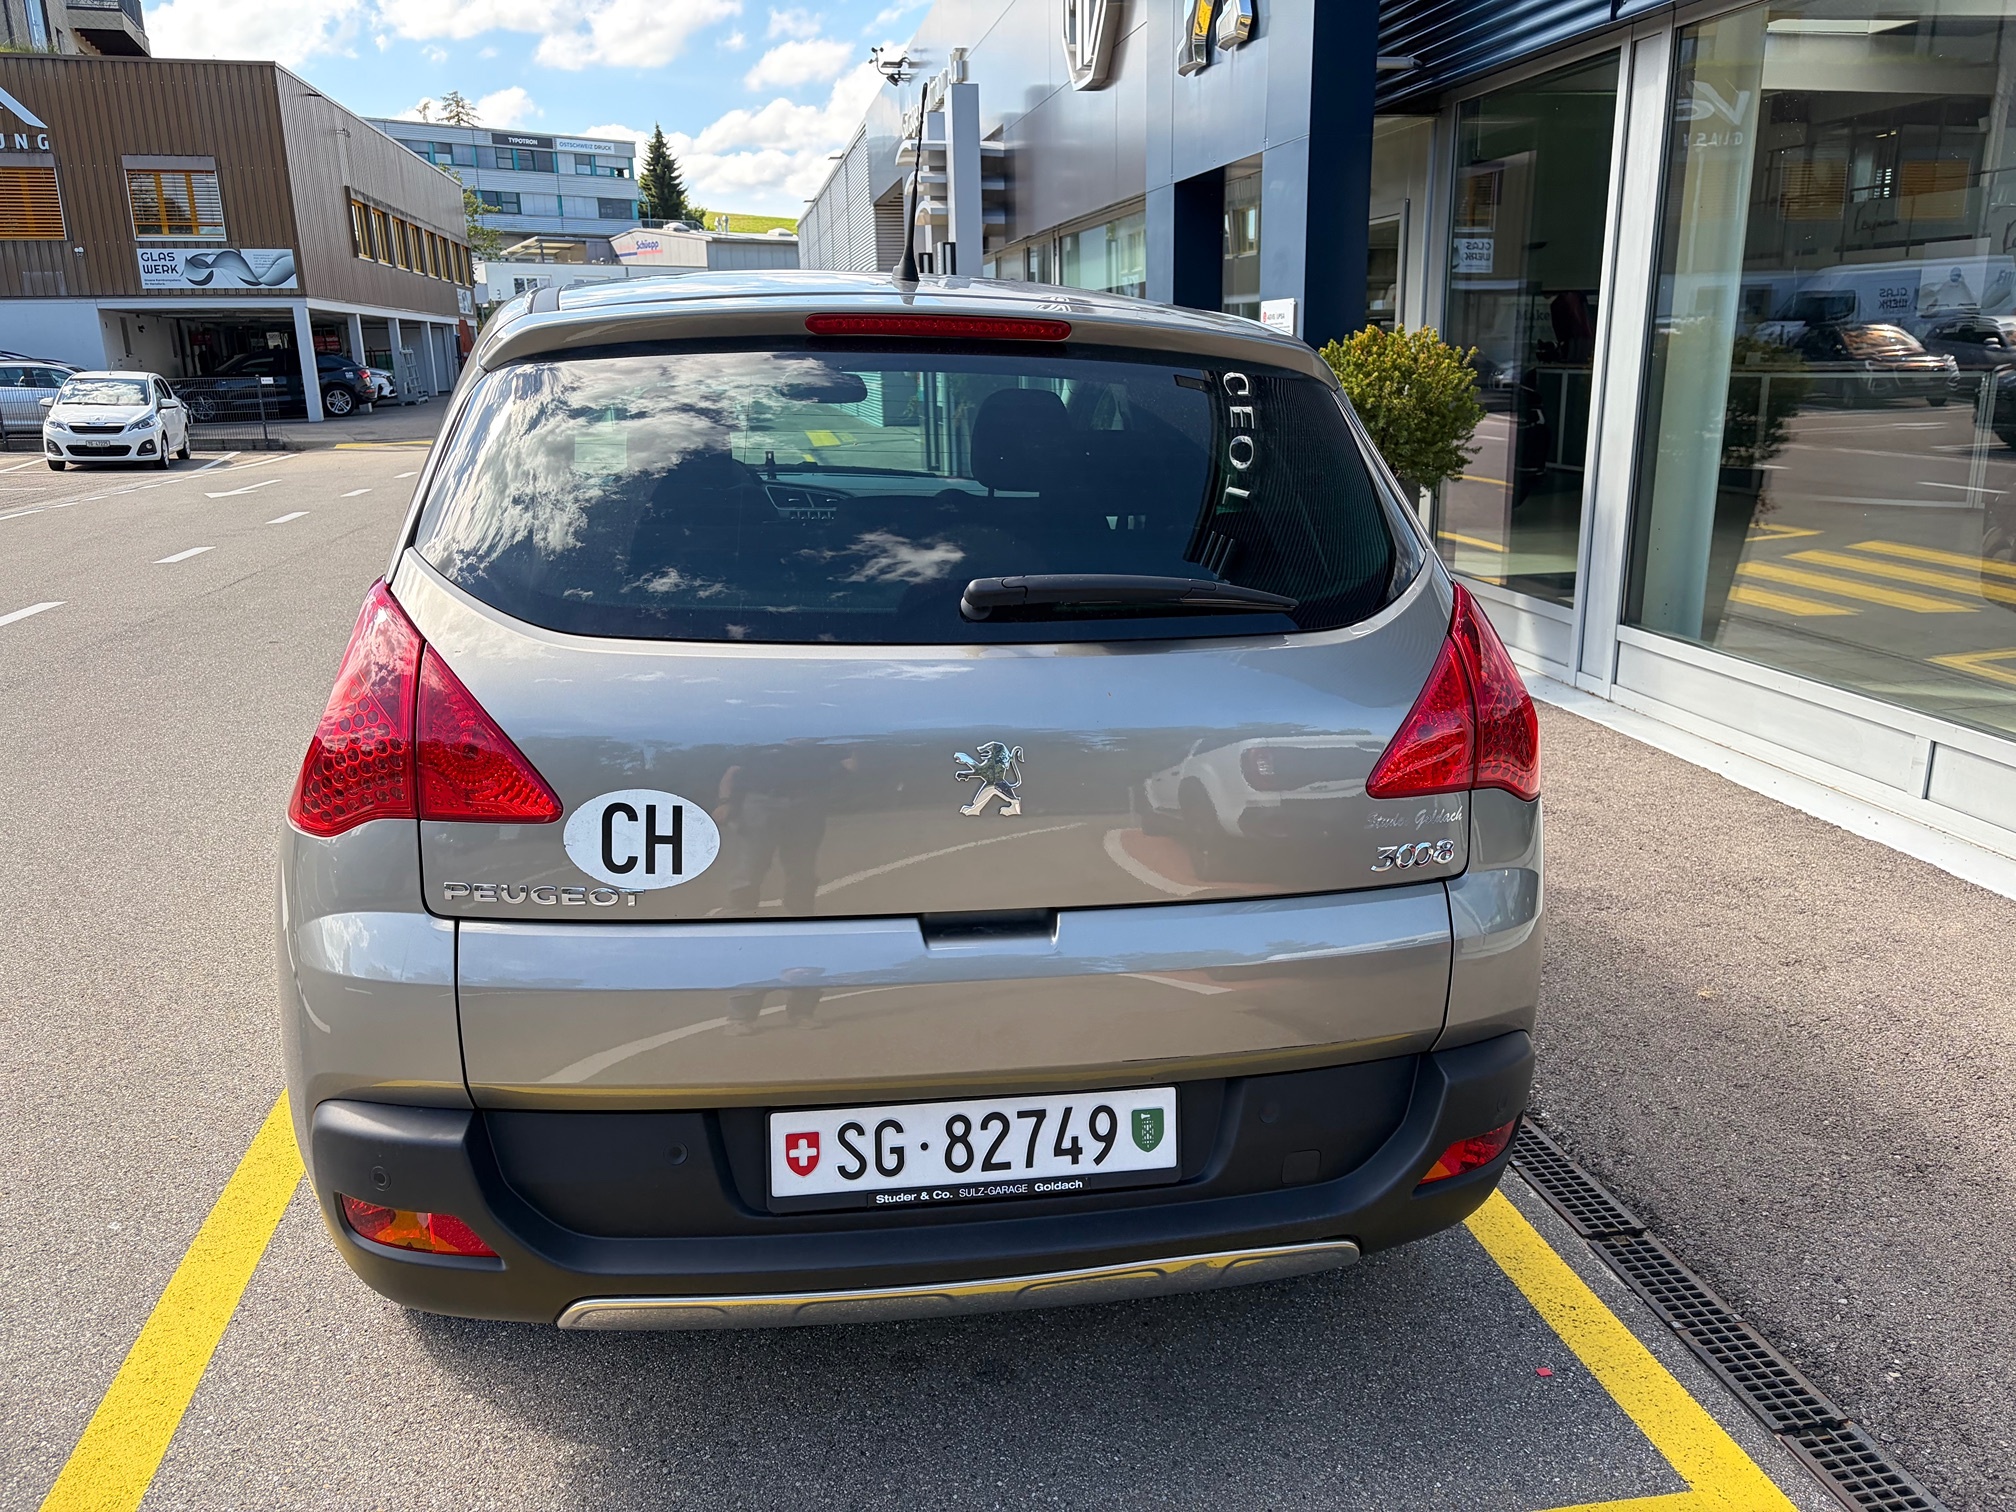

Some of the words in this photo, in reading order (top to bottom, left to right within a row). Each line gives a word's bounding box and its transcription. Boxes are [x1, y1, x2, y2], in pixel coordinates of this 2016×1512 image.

[508, 136, 538, 146] TYPOTRON
[558, 141, 594, 150] OSTSCHWEIZ
[594, 143, 612, 151] DRUCK
[140, 252, 175, 262] GLAS
[142, 264, 179, 275] WERK
[1414, 805, 1463, 831] Goldach
[601, 802, 683, 875] CH
[1370, 838, 1455, 872] 3008
[443, 881, 645, 907] PEUGEOT
[836, 1118, 905, 1180] SG
[944, 1104, 1118, 1174] 82749
[875, 1192, 917, 1204] Studer
[920, 1191, 930, 1201] &
[932, 1189, 953, 1200] Co.
[958, 1183, 1028, 1198] SULZ-GARAGE
[1034, 1179, 1083, 1192] Goldach
